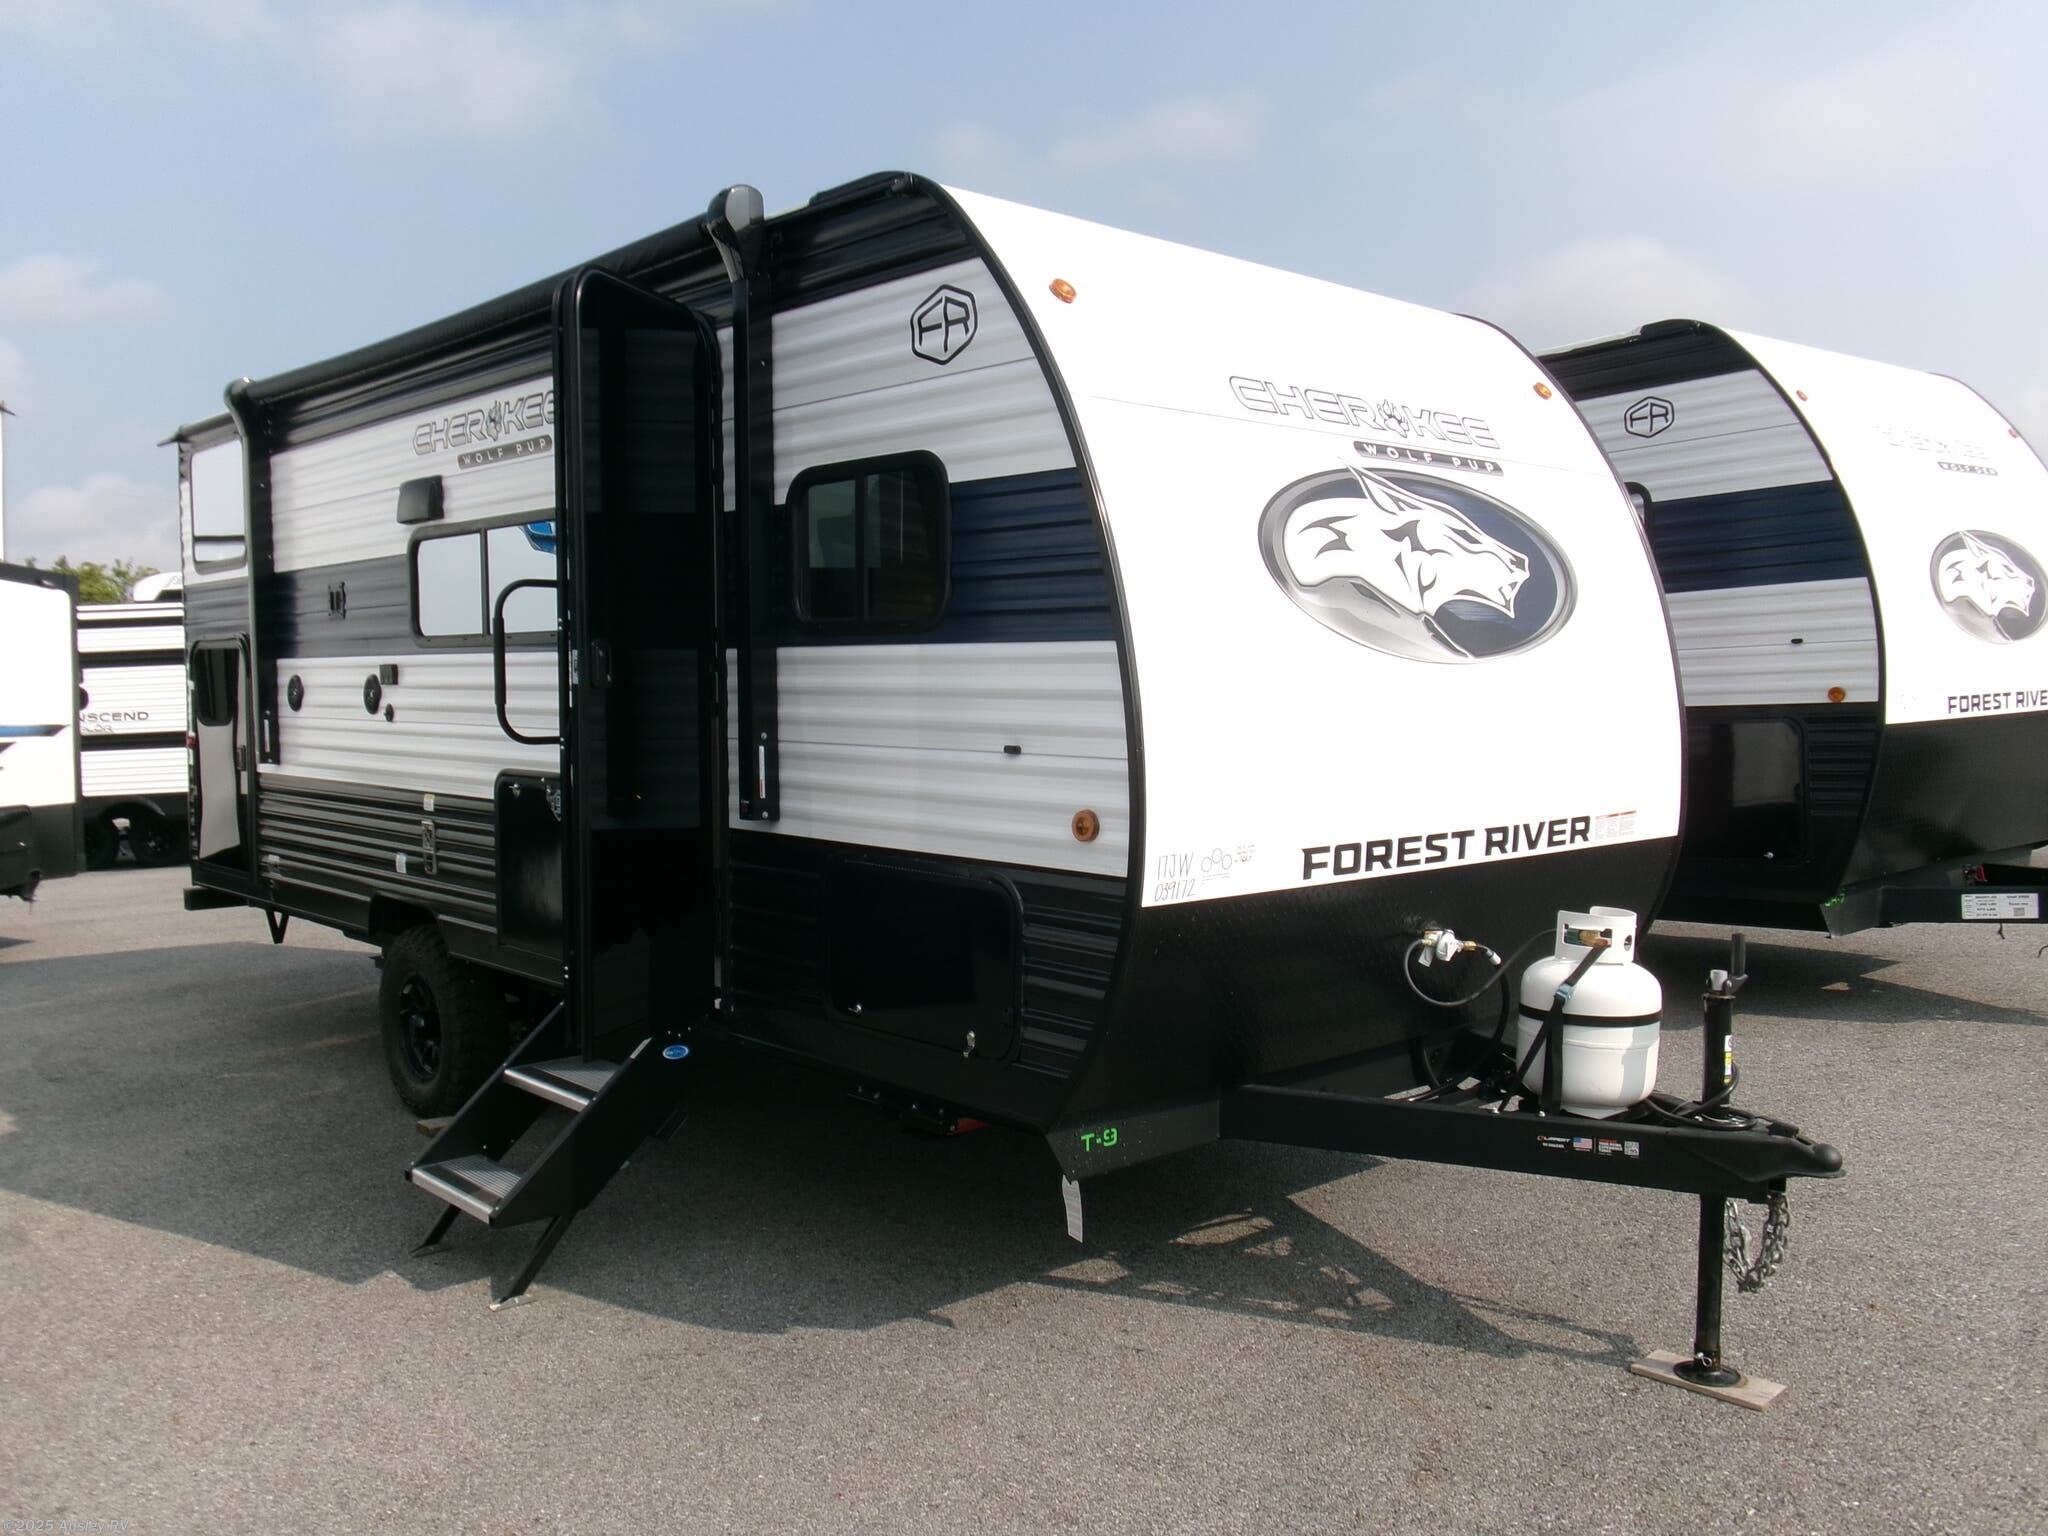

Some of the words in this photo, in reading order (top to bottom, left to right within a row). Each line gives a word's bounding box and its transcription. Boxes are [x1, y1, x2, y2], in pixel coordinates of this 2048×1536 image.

[1229, 375, 1501, 450] CHEROKEE
[463, 447, 504, 464] WOLF
[515, 438, 547, 454] PUP
[1363, 443, 1433, 464] WOLF
[1451, 456, 1495, 473] PUP
[1948, 692, 2011, 714] FOREST
[2016, 690, 2048, 708] RIVE
[1301, 829, 1475, 880] FOREST
[1484, 815, 1591, 856] RIVER
[1155, 878, 1196, 902] 039172
